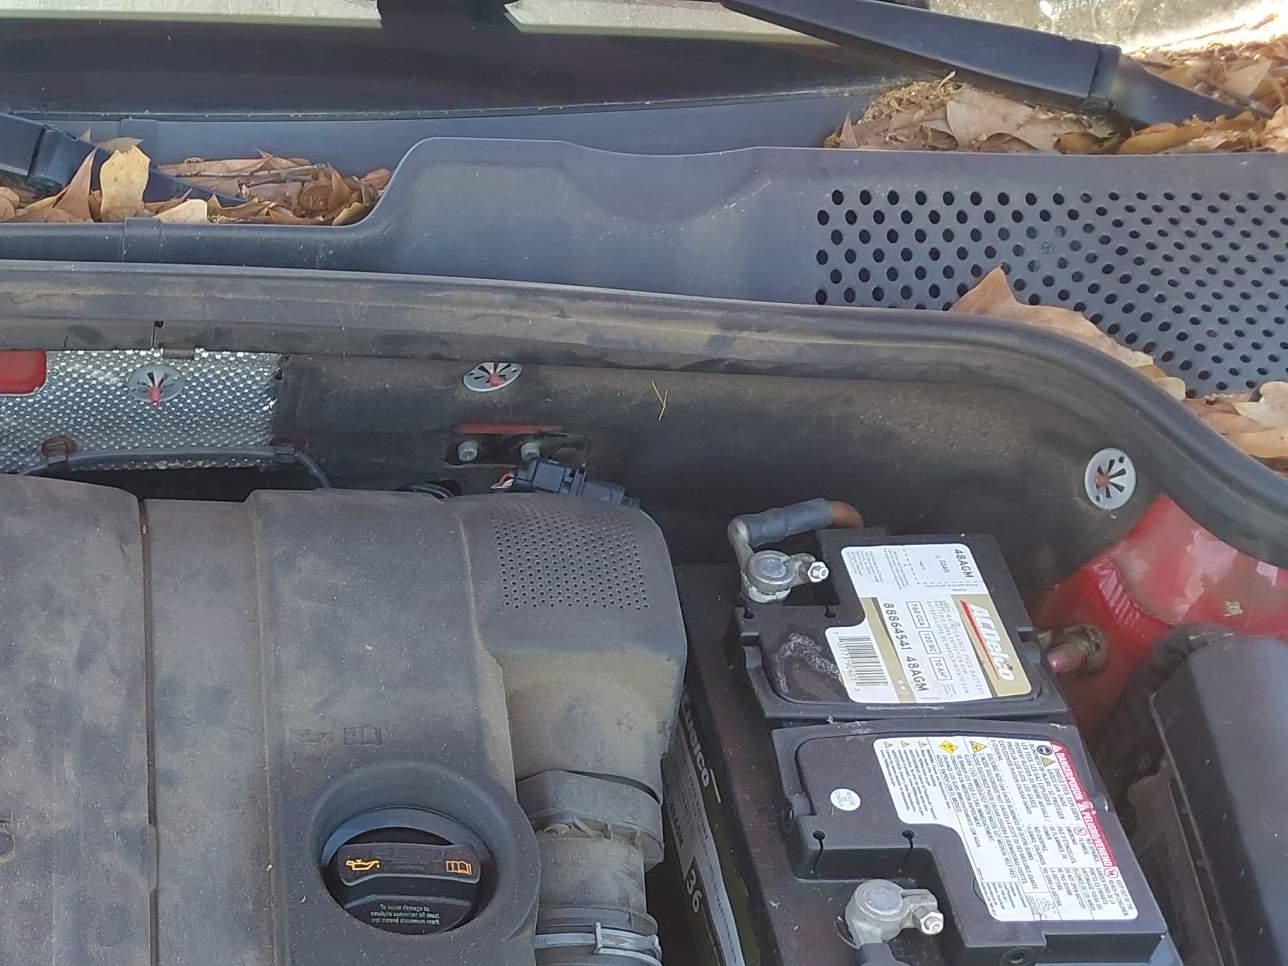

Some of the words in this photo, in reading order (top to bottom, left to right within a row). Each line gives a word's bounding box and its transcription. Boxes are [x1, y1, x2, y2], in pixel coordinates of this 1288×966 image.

[953, 549, 974, 577] 48AGM
[882, 603, 911, 649] 88864541
[903, 656, 929, 691] 48AGM
[969, 604, 1017, 680] ACDelco
[686, 869, 702, 913] 36
